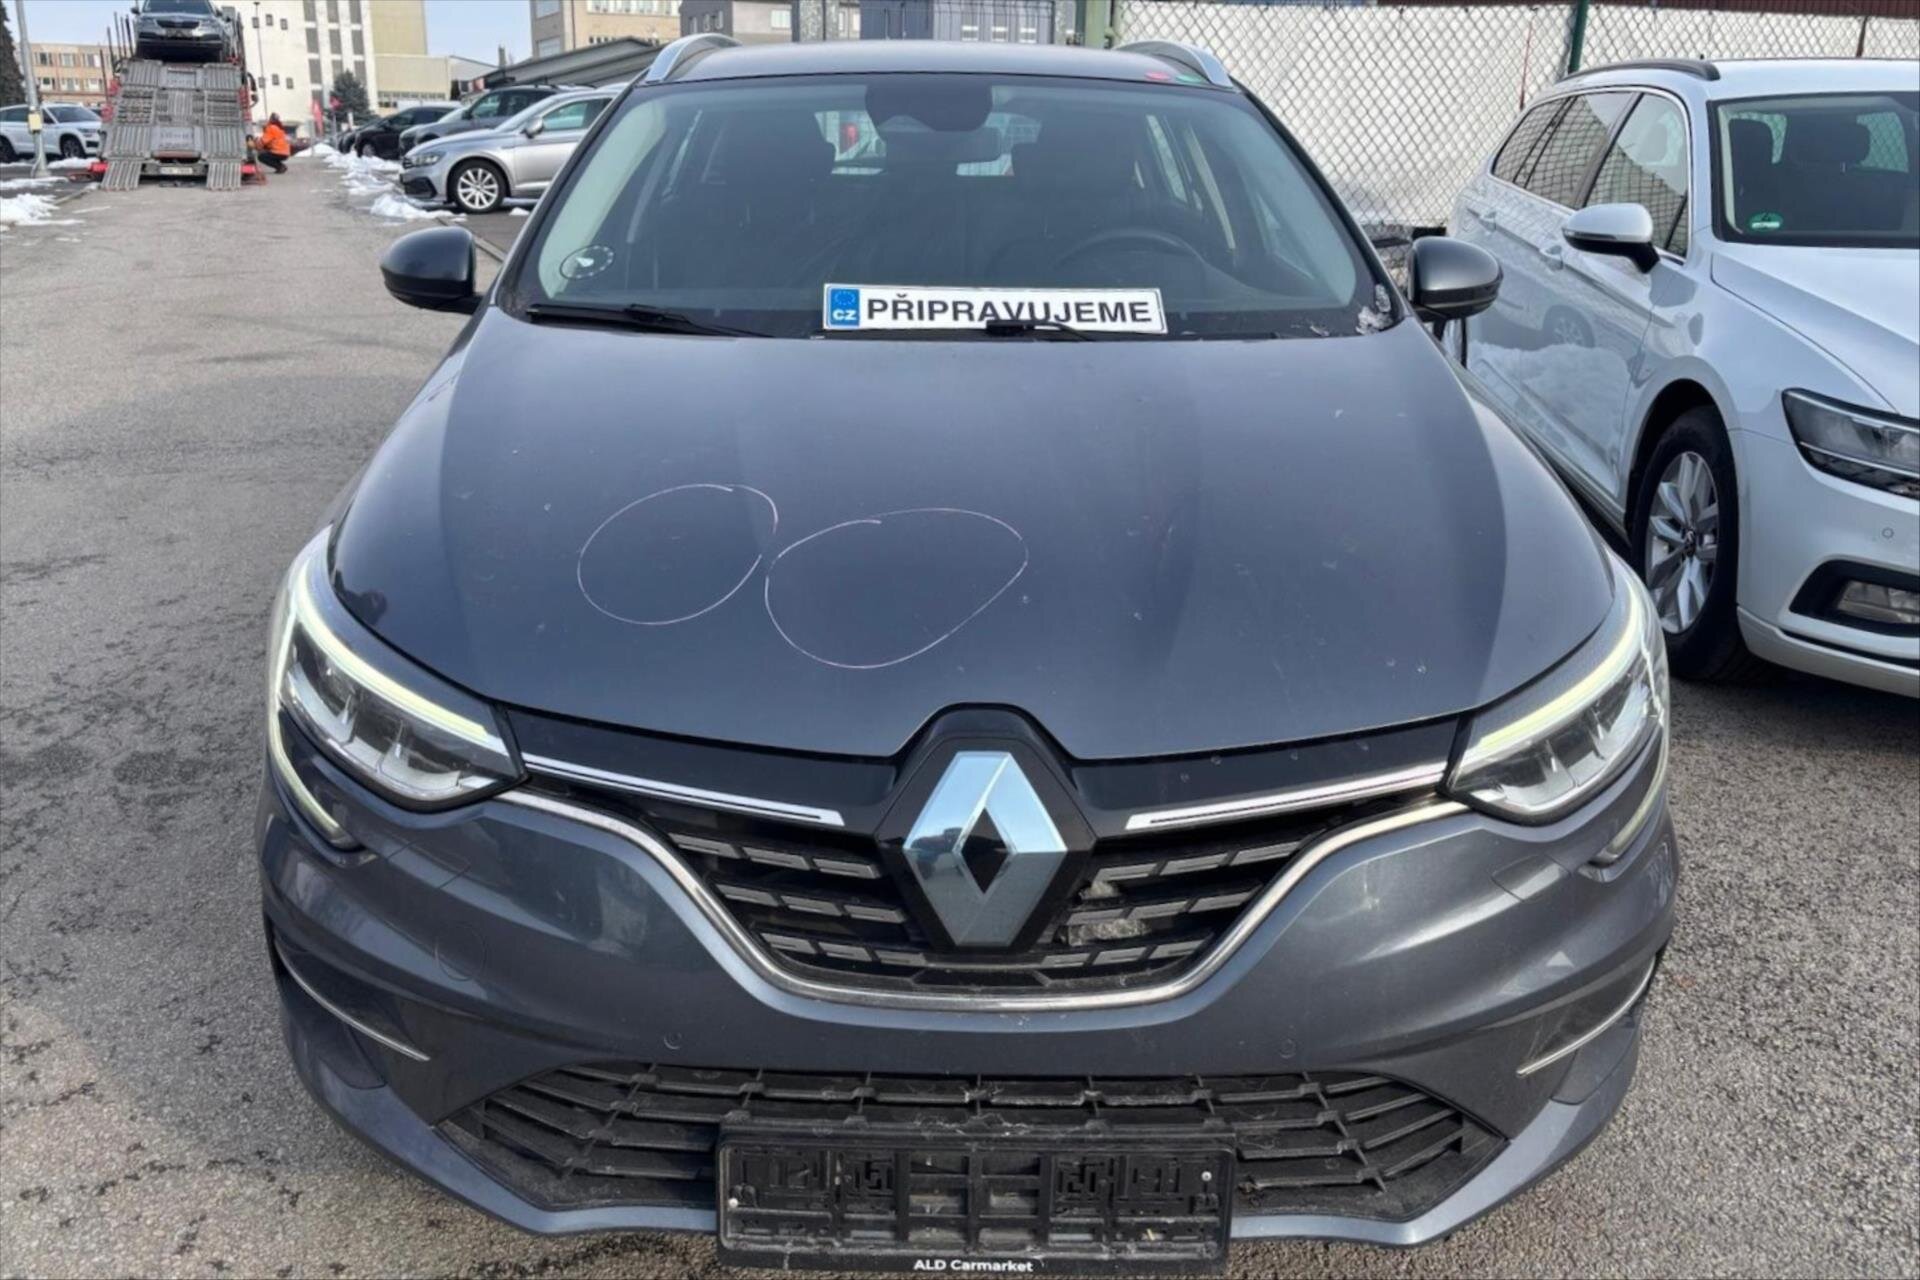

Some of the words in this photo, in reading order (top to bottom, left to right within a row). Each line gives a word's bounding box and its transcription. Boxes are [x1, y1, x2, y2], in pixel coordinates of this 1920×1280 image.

[832, 308, 857, 321] CZ
[866, 293, 1153, 323] PŘIPRAVUJEME
[913, 1259, 947, 1271] ALD
[950, 1259, 1034, 1272] Carmarket
